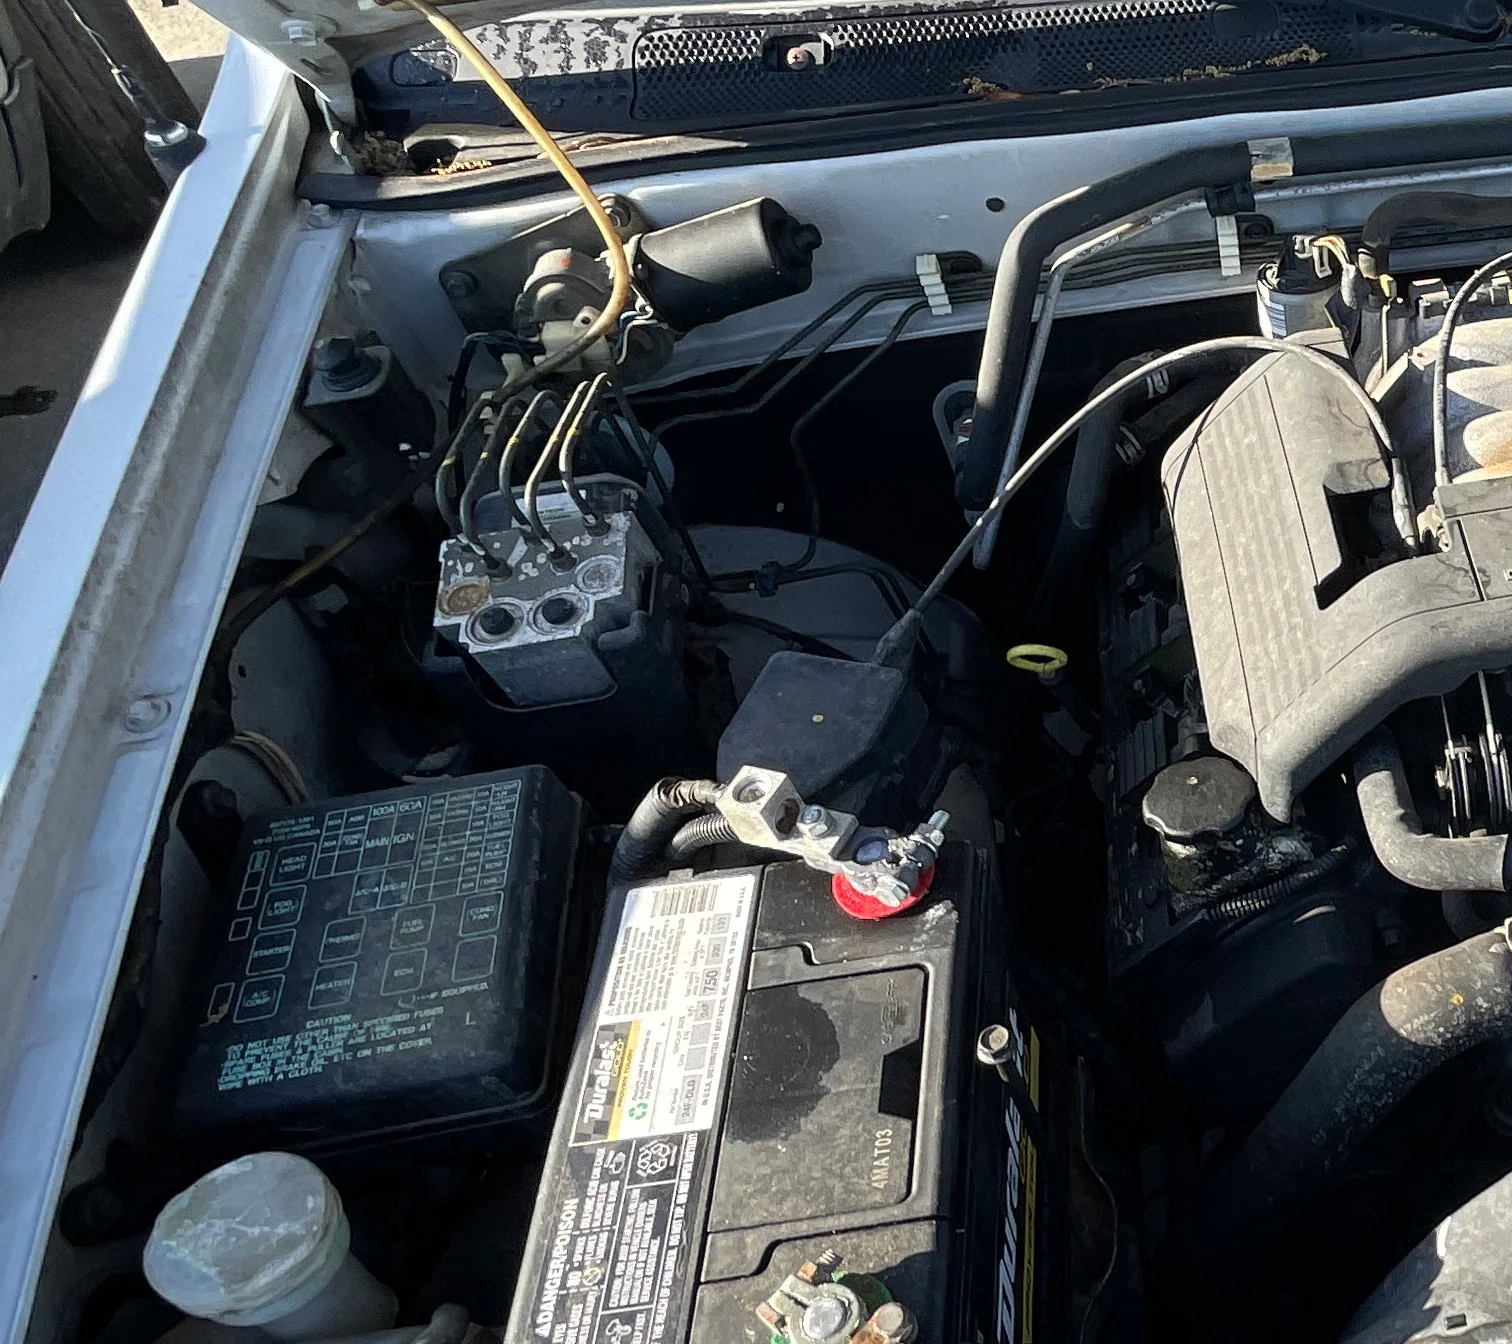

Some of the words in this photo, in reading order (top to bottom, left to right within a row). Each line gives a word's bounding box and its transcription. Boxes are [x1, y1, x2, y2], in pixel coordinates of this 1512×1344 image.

[373, 805, 395, 816] 100A
[365, 837, 390, 849] MAIN
[393, 832, 415, 844] IGN
[703, 969, 718, 993] 750
[304, 1013, 351, 1029] CAUTION
[369, 1025, 416, 1041] LOCATED
[612, 1040, 624, 1077] GOLD
[583, 1039, 616, 1123] Duralast
[871, 1127, 893, 1190] 4MAT03
[671, 1217, 682, 1233] NOT
[669, 1233, 679, 1246] DO
[536, 1197, 579, 1323] DANGER/POISON
[566, 1269, 581, 1288] NO
[660, 1285, 670, 1297] OF
[655, 1297, 668, 1323] REACH
[652, 1323, 663, 1339] THE
